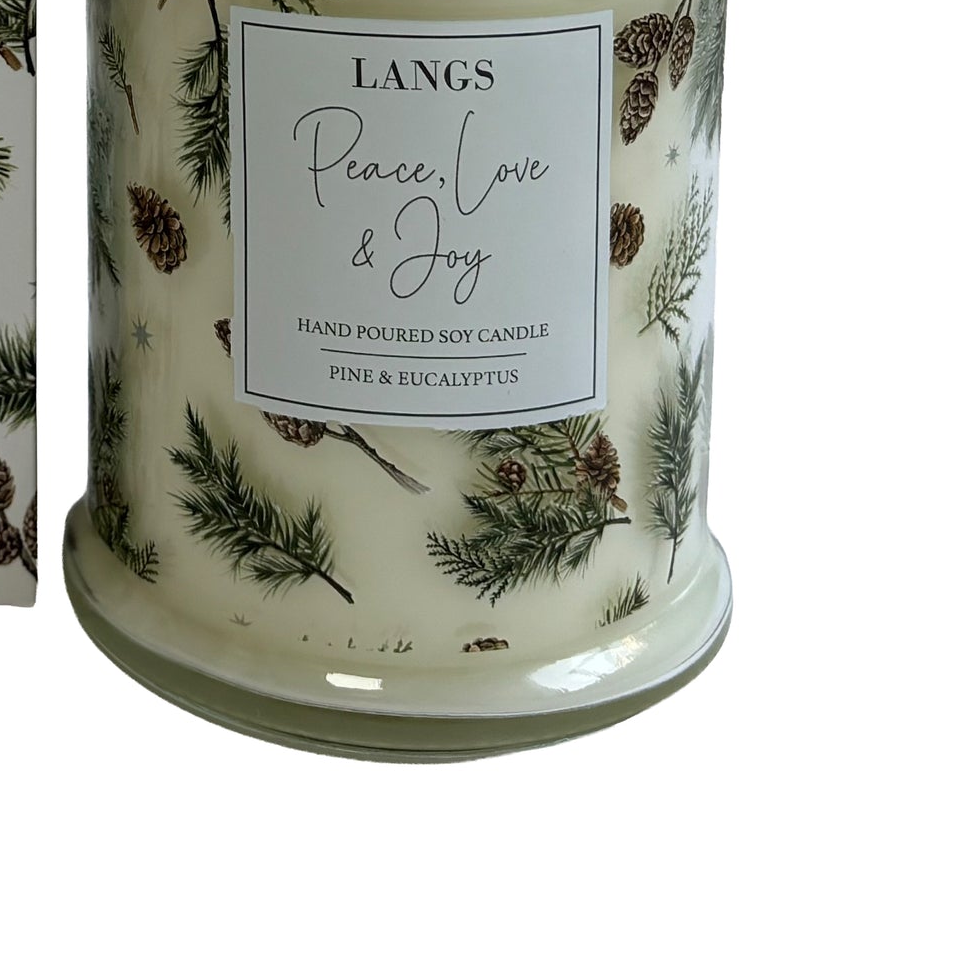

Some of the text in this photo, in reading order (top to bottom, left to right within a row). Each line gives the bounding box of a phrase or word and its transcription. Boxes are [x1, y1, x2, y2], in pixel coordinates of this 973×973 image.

[351, 56, 495, 92] LANGS
[293, 106, 550, 216] Peace, Love
[351, 195, 493, 306] & Joy
[297, 317, 550, 344] HAND POURED SOY CANDLE
[329, 364, 519, 387] PINE & EUCALYPTUS
